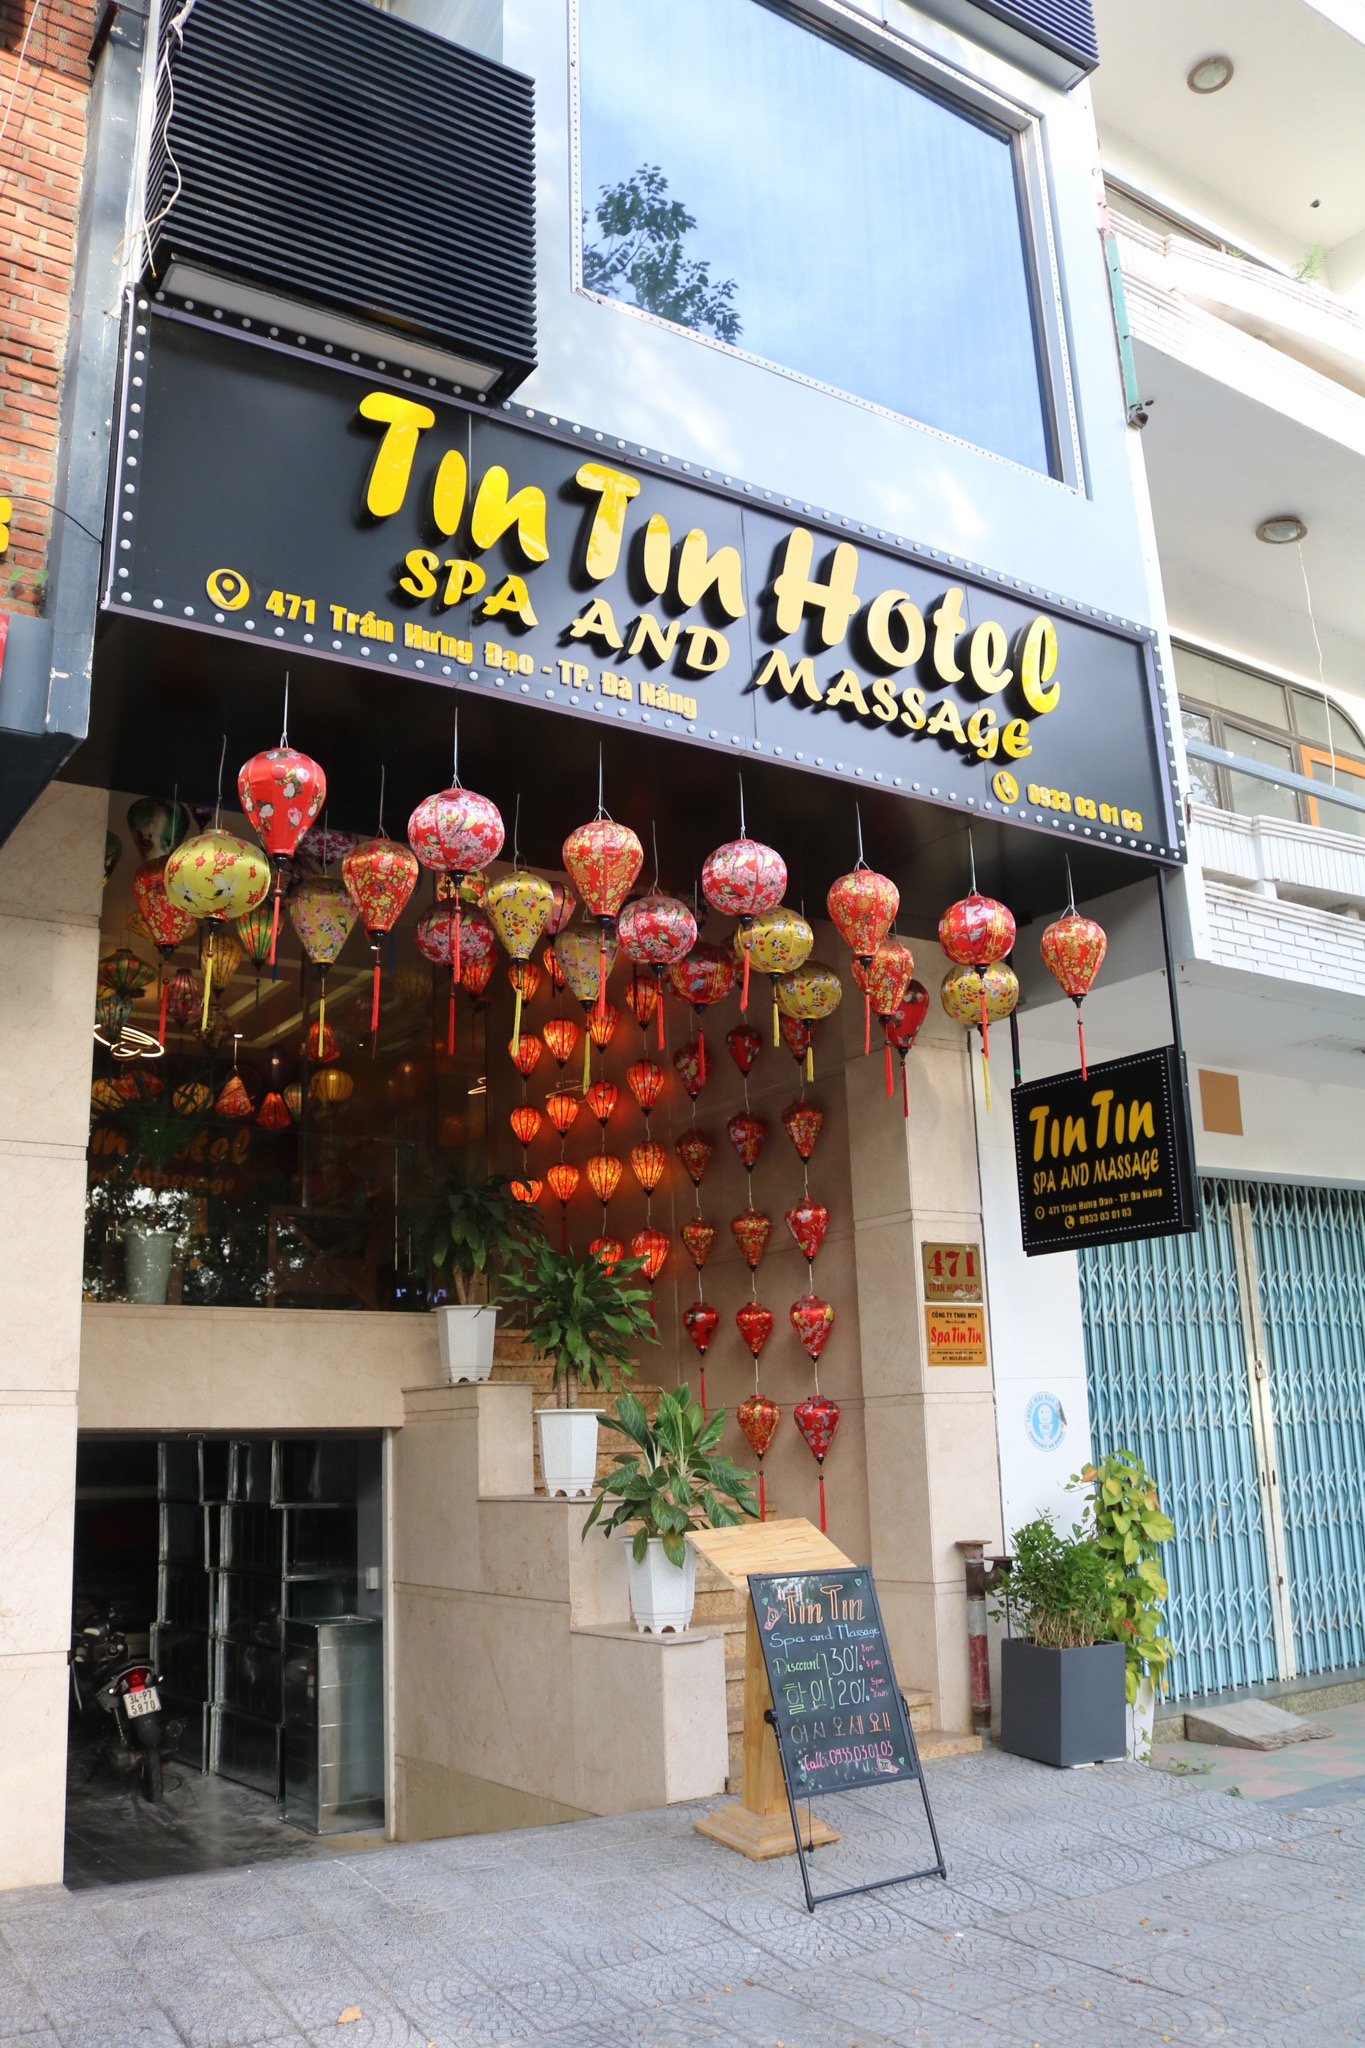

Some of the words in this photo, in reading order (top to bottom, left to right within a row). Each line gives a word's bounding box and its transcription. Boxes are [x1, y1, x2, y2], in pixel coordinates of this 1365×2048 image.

[399, 548, 540, 627] SPA
[570, 598, 731, 672] AND
[773, 526, 1061, 714] Hotel
[265, 589, 316, 625] 471
[329, 603, 395, 643] Trần
[404, 621, 474, 665] Hưng
[556, 658, 594, 691] TP.
[600, 670, 633, 701] Đà
[639, 679, 698, 720] Nẵng
[1027, 783, 1072, 814] 0933
[1074, 795, 1098, 820] 03
[1099, 802, 1120, 827] 01
[1121, 808, 1143, 832] 03
[1033, 1171, 1057, 1196] SPA
[1061, 1161, 1089, 1191] AND
[1093, 1147, 1160, 1185] MASSAGE
[1048, 1205, 1060, 1216] 471
[1079, 1212, 1098, 1225] 0933
[1099, 1210, 1110, 1222] 03
[1111, 1208, 1121, 1220] 01
[1121, 1206, 1132, 1218] 03
[927, 1249, 977, 1278] 471
[930, 1326, 951, 1347] Spa
[951, 1326, 966, 1344] Tin
[967, 1326, 982, 1344] Tin
[769, 1632, 805, 1659] Spa
[810, 1626, 834, 1642] and
[835, 1623, 881, 1641] Massage
[773, 1652, 821, 1677] Discount
[830, 1645, 864, 1676] 30%
[130, 1699, 156, 1715] 5870
[837, 1678, 871, 1707] 20%
[803, 1753, 829, 1772] Call:
